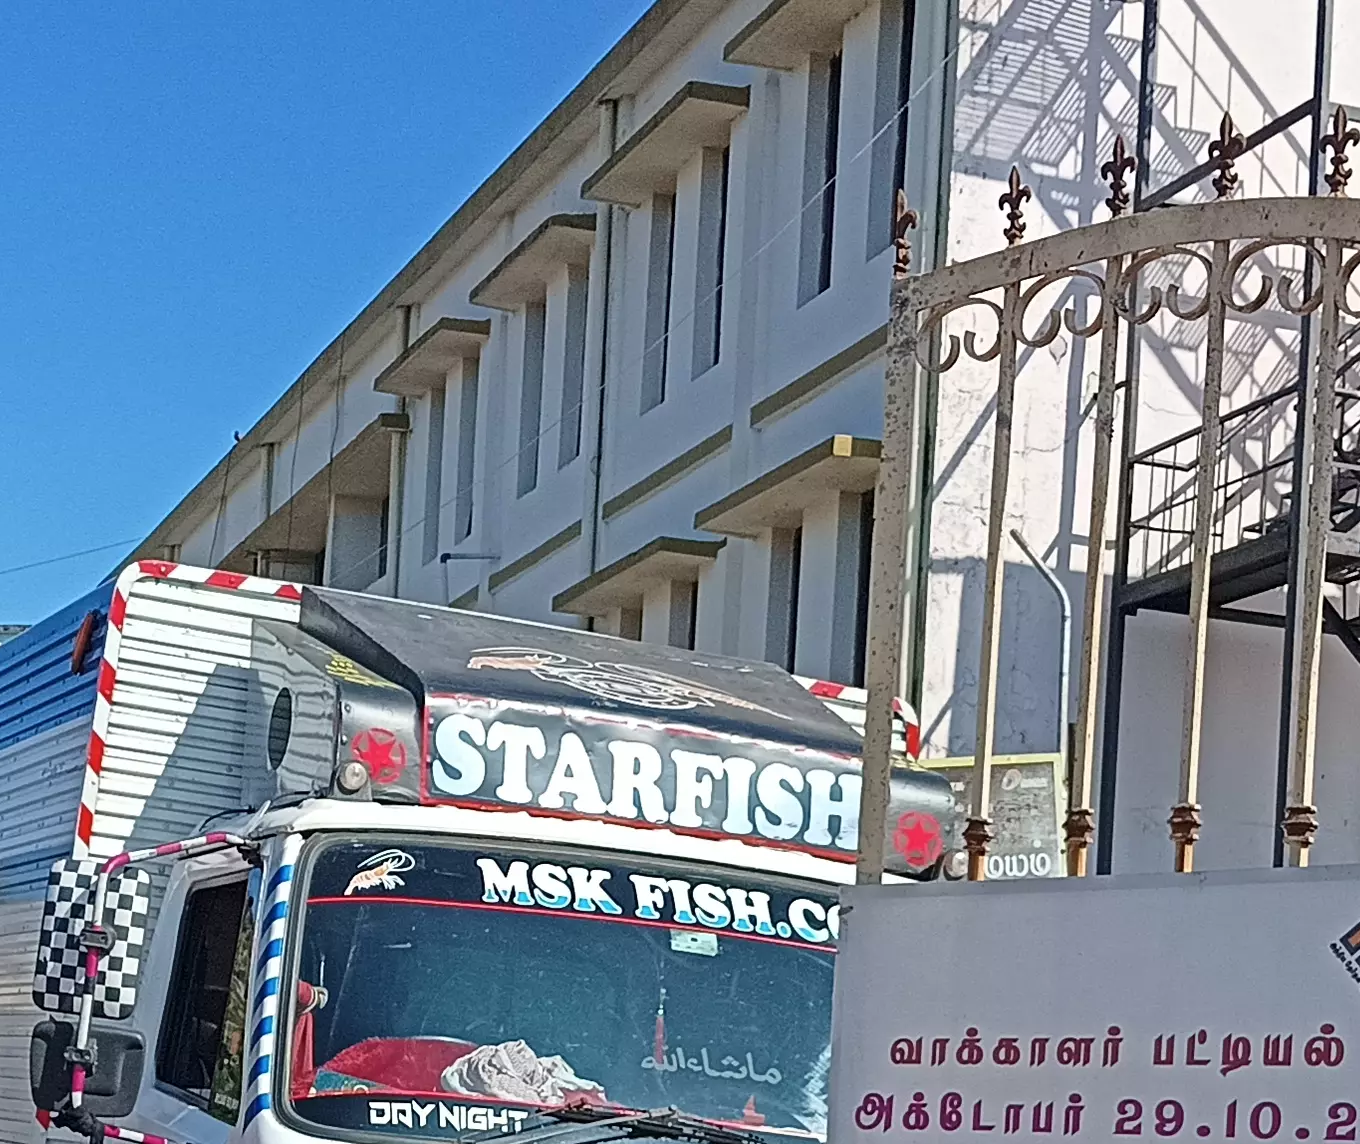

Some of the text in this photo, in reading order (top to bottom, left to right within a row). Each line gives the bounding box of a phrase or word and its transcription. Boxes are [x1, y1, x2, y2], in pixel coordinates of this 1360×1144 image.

[433, 712, 863, 851] STARFISH
[476, 857, 623, 917] MSK
[891, 1026, 1123, 1067] வாக்காளர்
[1153, 1024, 1344, 1077] பட்டியல்
[855, 1092, 1085, 1135] அக்டோபர்
